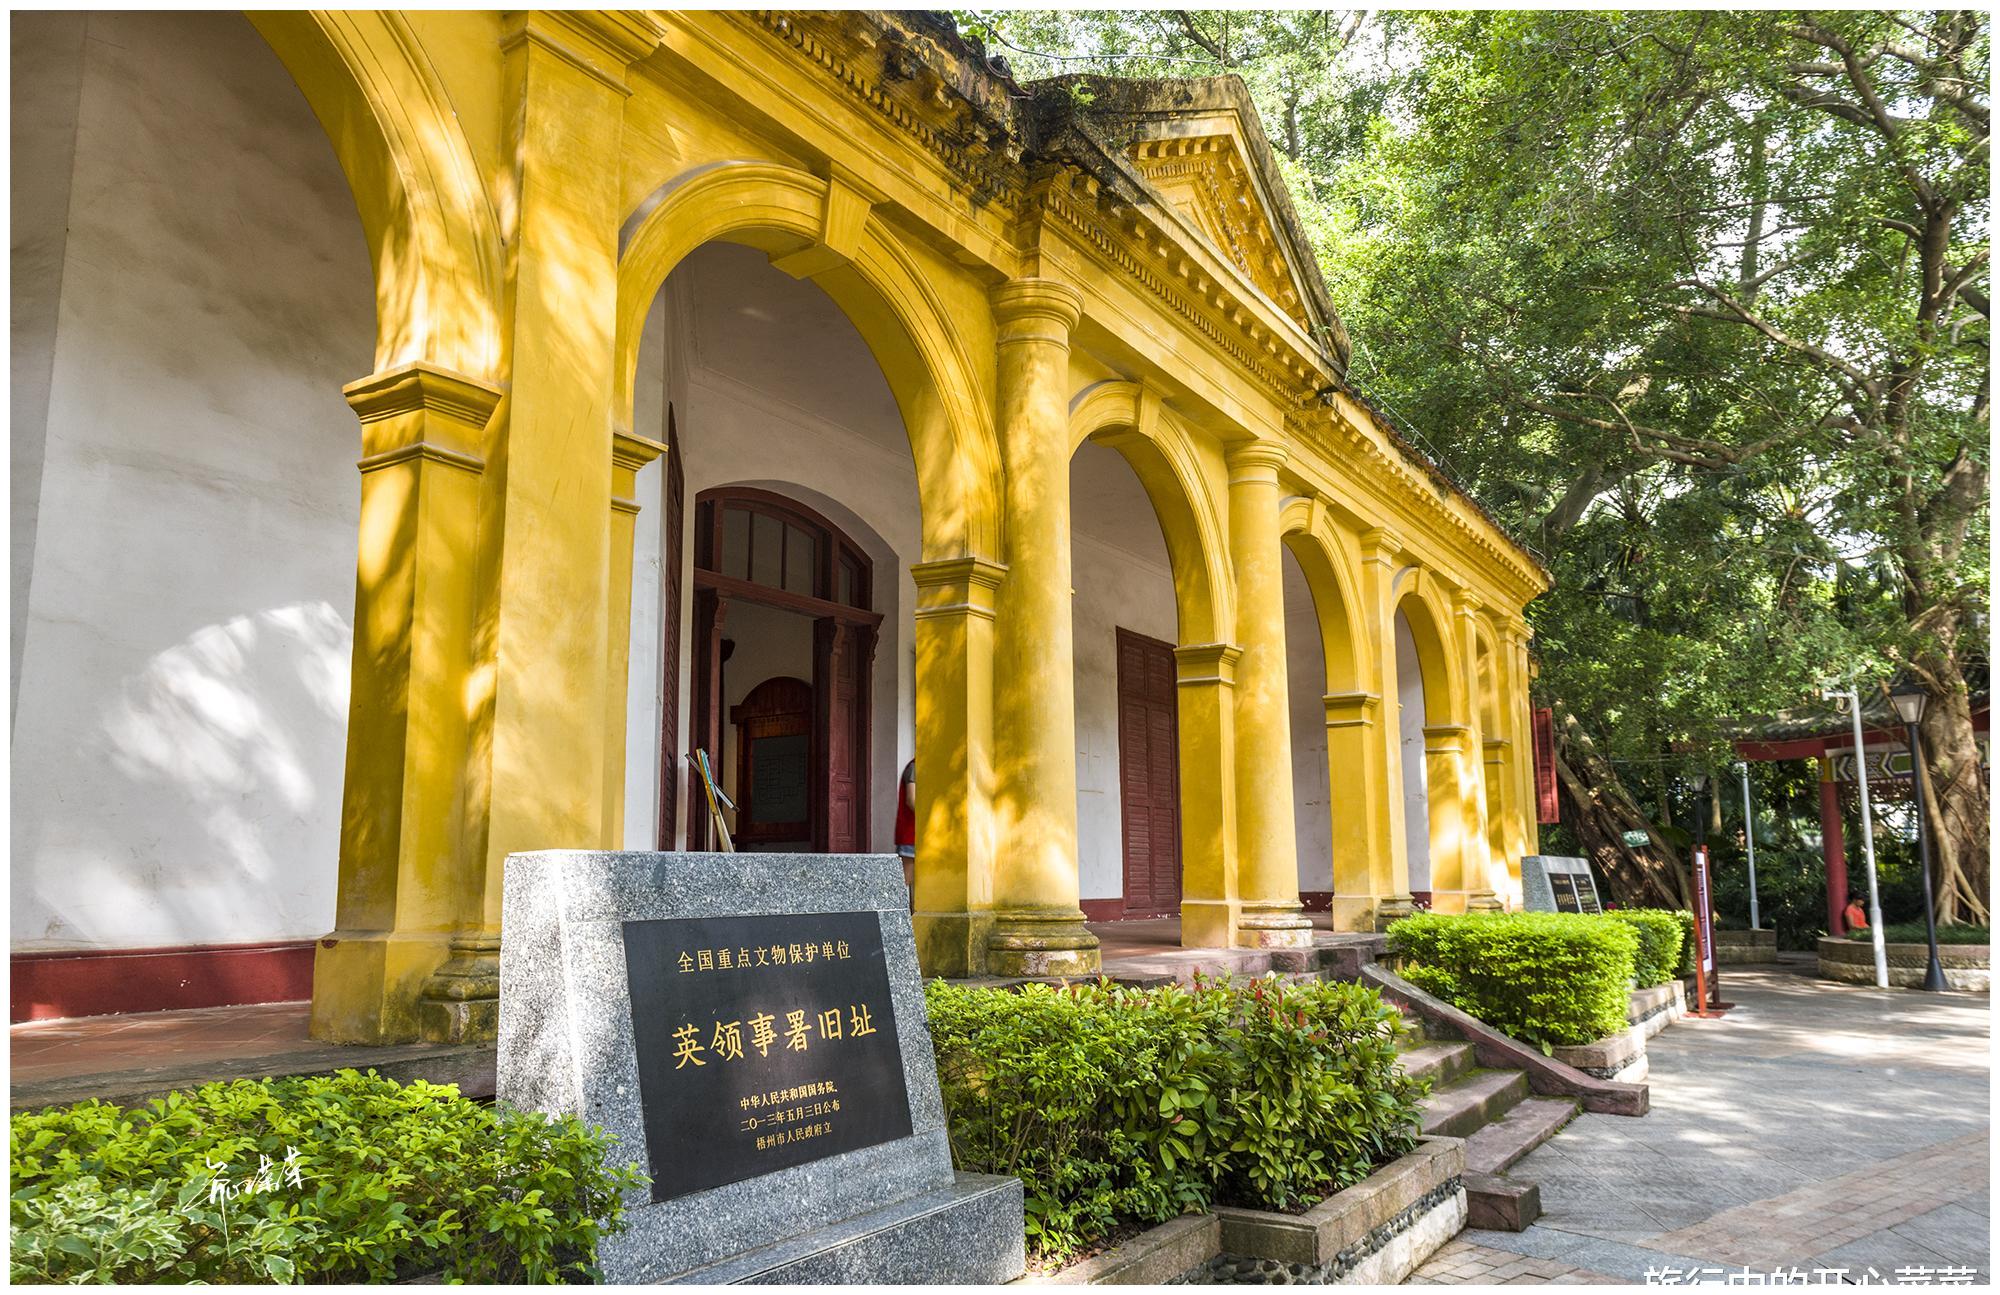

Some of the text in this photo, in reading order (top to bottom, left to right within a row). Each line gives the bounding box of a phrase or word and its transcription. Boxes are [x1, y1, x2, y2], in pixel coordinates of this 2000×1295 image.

[677, 940, 851, 973] 全国重点文物保护单位
[671, 1003, 877, 1070] 英领事署旧址
[740, 1080, 836, 1111] 中华人民共和国国务院
[756, 1121, 832, 1151] 梧州市人民政府立
